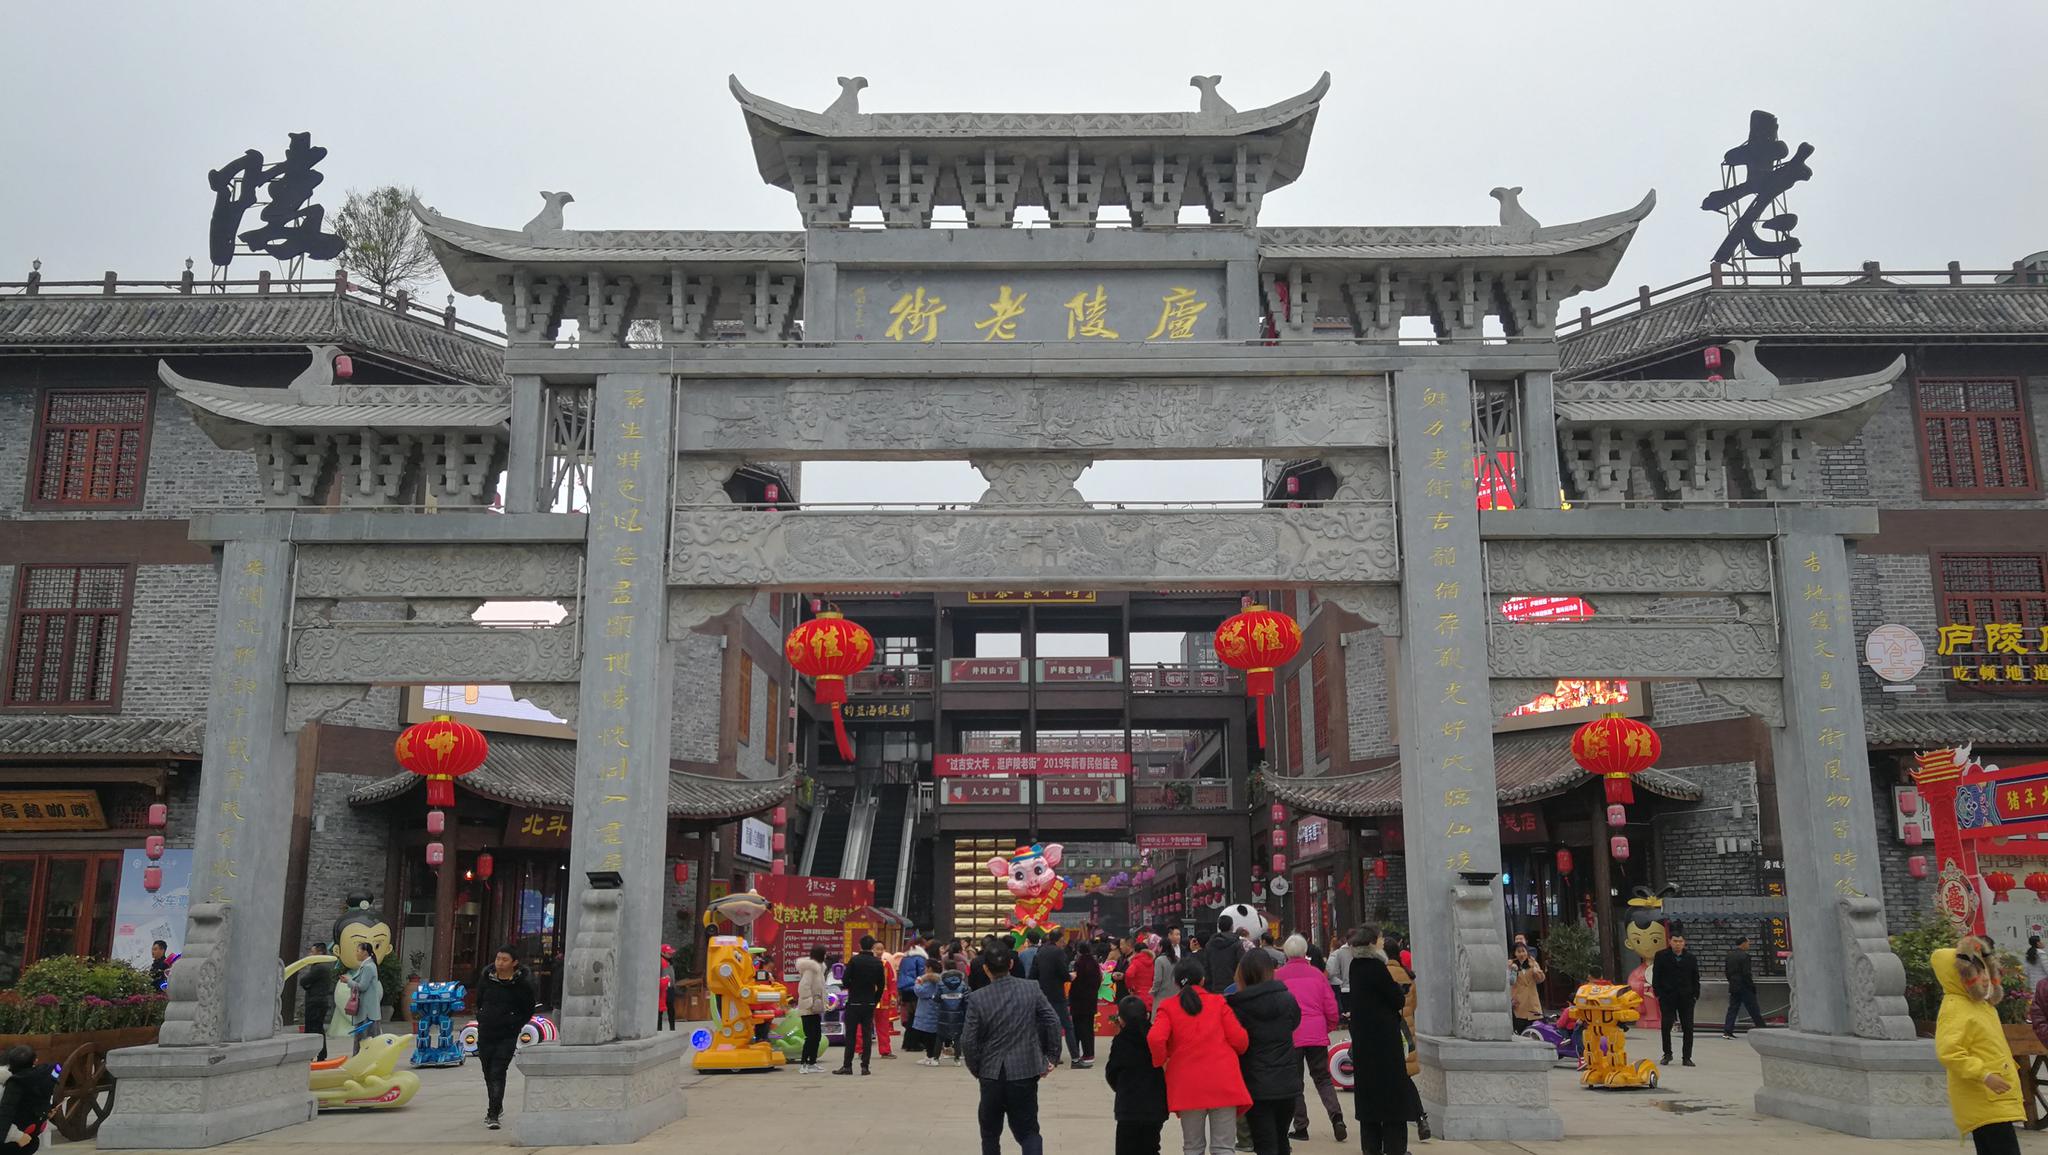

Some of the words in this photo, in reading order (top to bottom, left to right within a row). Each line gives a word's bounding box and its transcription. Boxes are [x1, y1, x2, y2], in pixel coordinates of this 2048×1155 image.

[208, 131, 346, 266] 陵
[1701, 110, 1815, 263] 老
[1043, 757, 1119, 770] 2019年新春民俗庙会
[521, 813, 568, 837] 北斗
[773, 902, 819, 924] 过吉安大年
